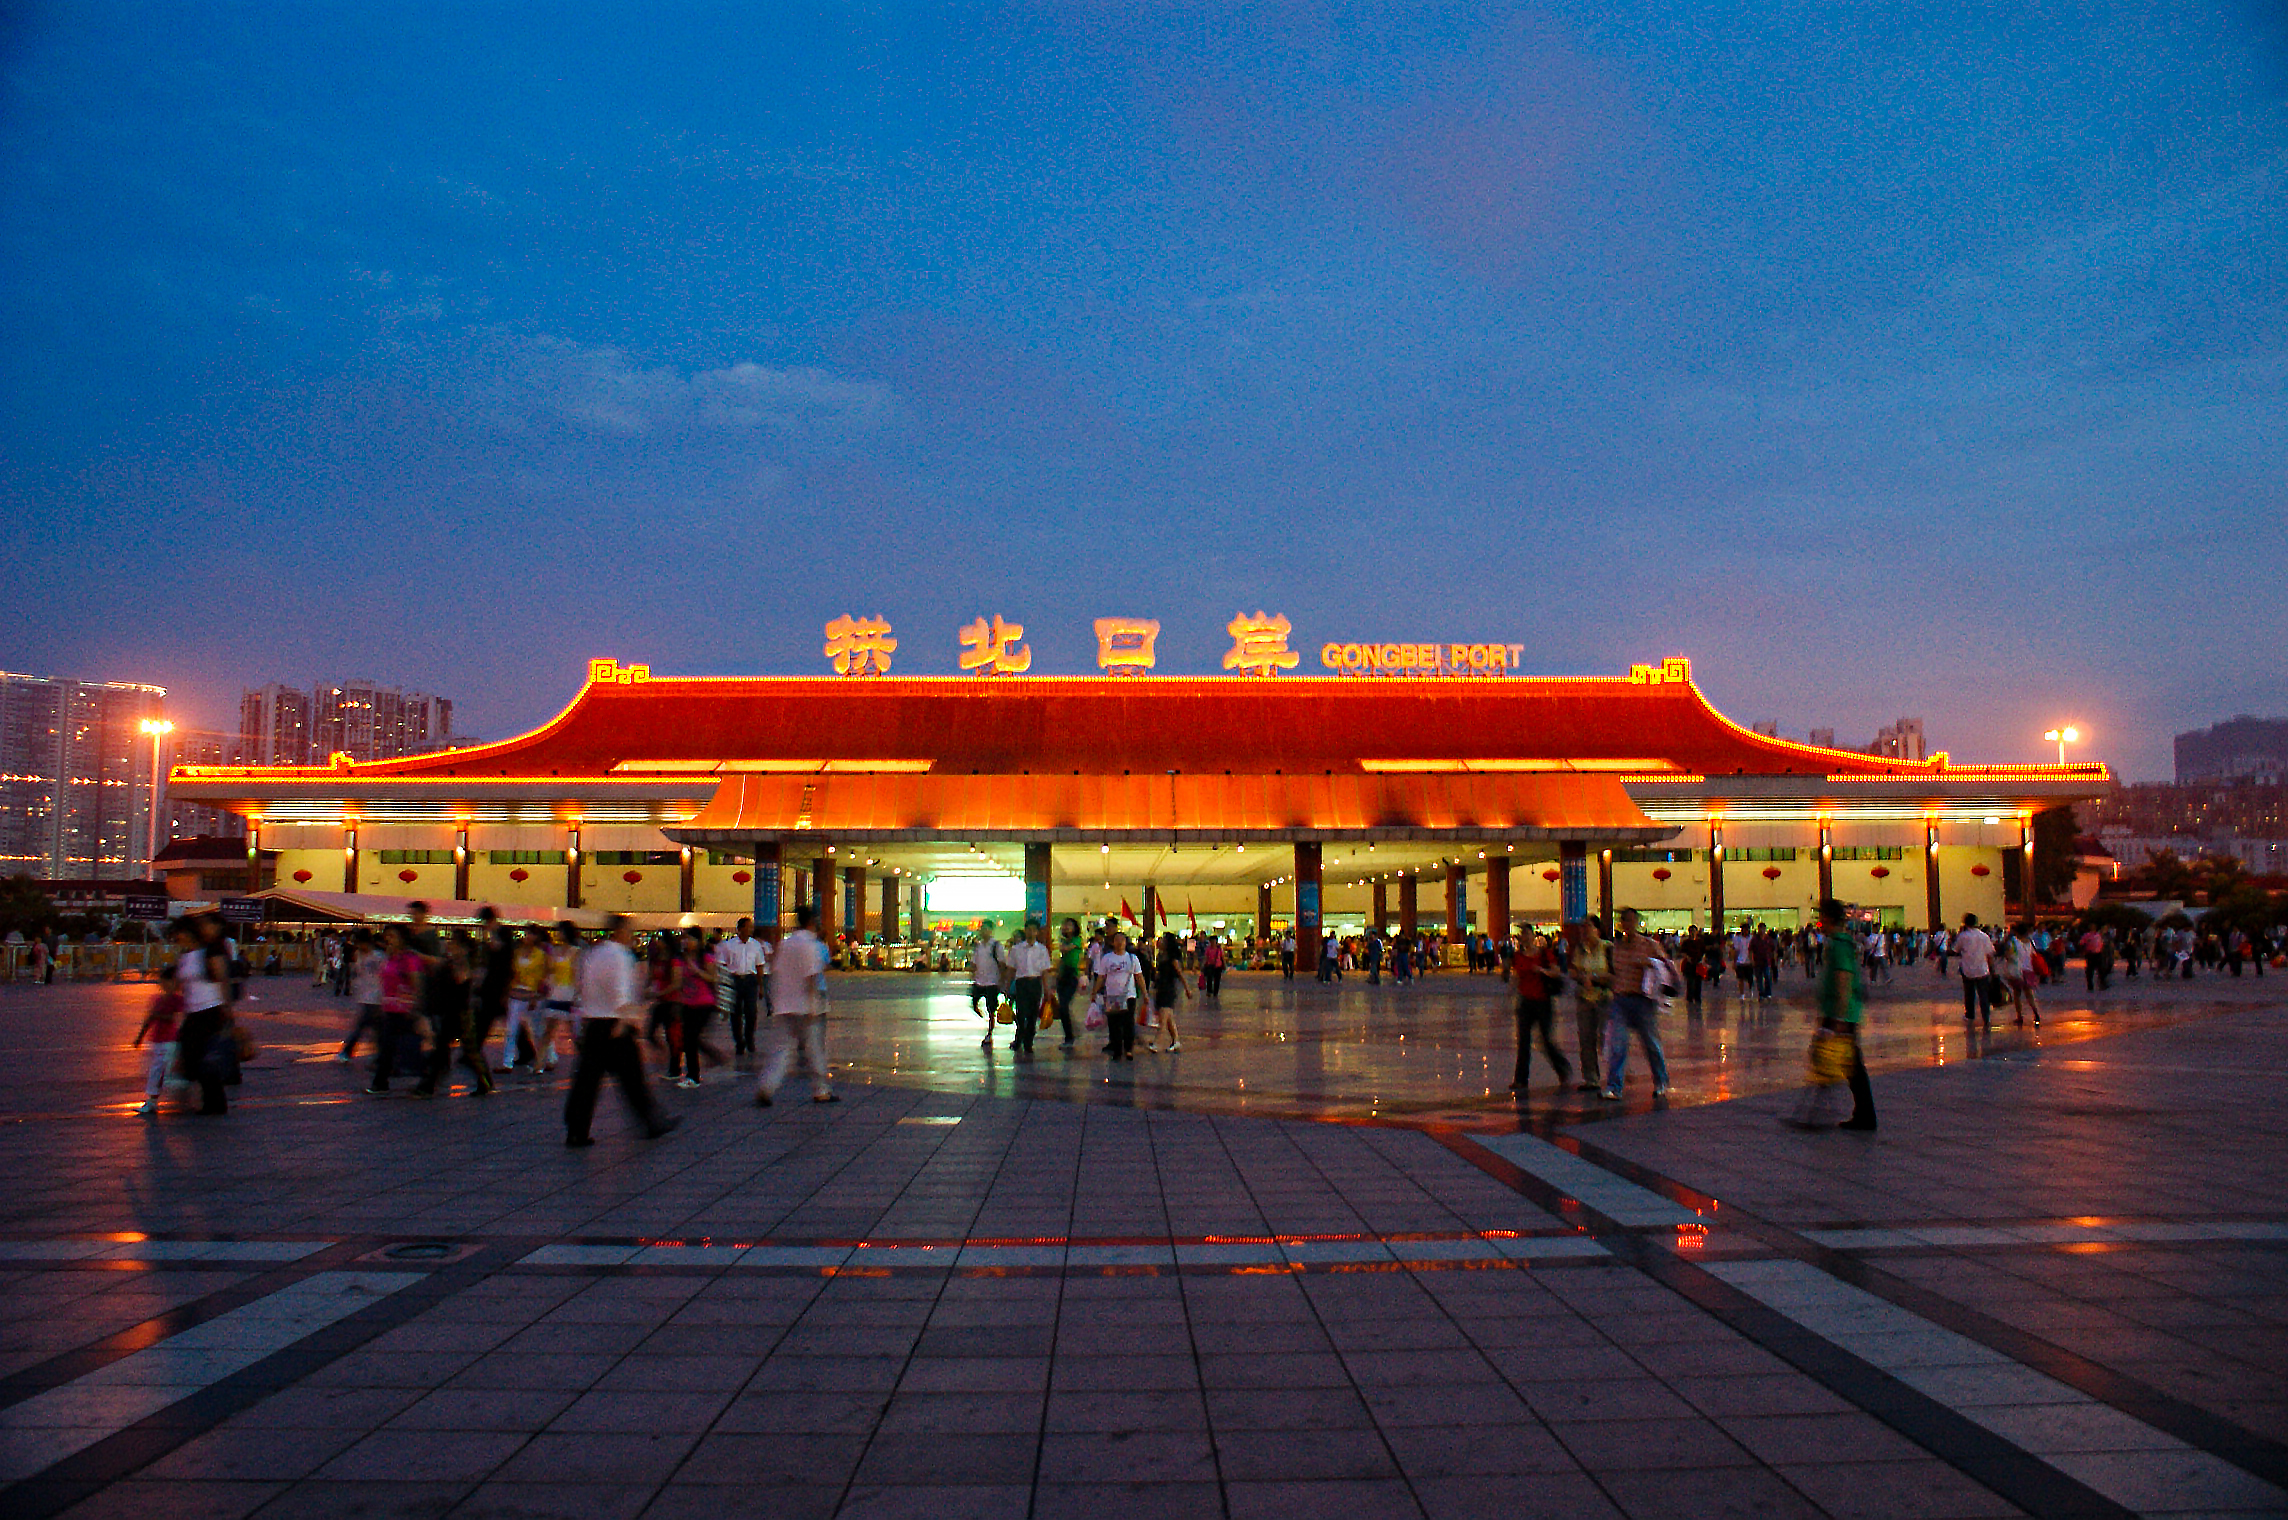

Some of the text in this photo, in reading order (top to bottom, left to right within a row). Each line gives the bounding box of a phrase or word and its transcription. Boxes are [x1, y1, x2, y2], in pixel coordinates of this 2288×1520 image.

[824, 610, 1300, 676] 拱北口岸
[1321, 642, 1524, 668] GONGBEI PORT
